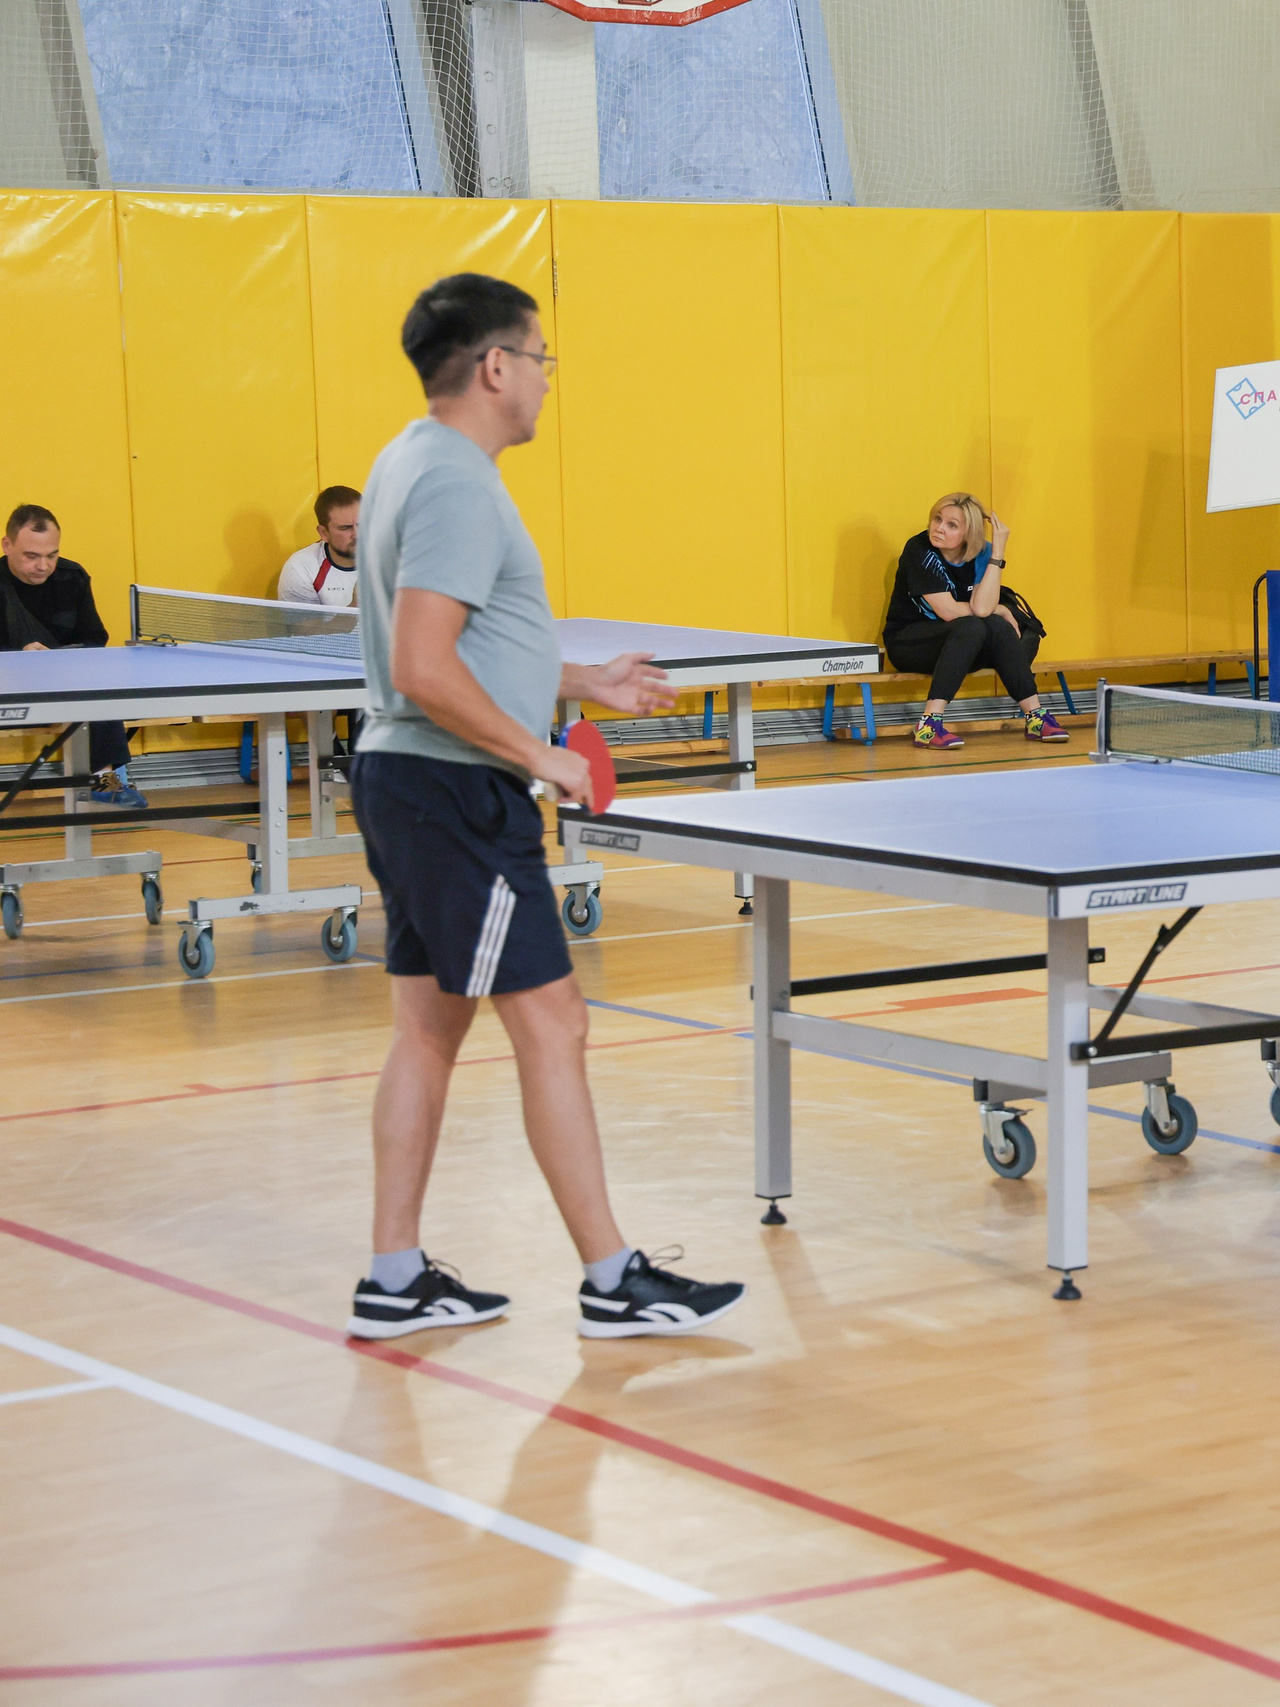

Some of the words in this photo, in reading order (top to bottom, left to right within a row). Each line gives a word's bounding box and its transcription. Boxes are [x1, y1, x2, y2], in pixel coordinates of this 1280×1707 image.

[822, 658, 864, 673] Champion
[1088, 887, 1148, 908] START
[1150, 883, 1185, 903] LINE
